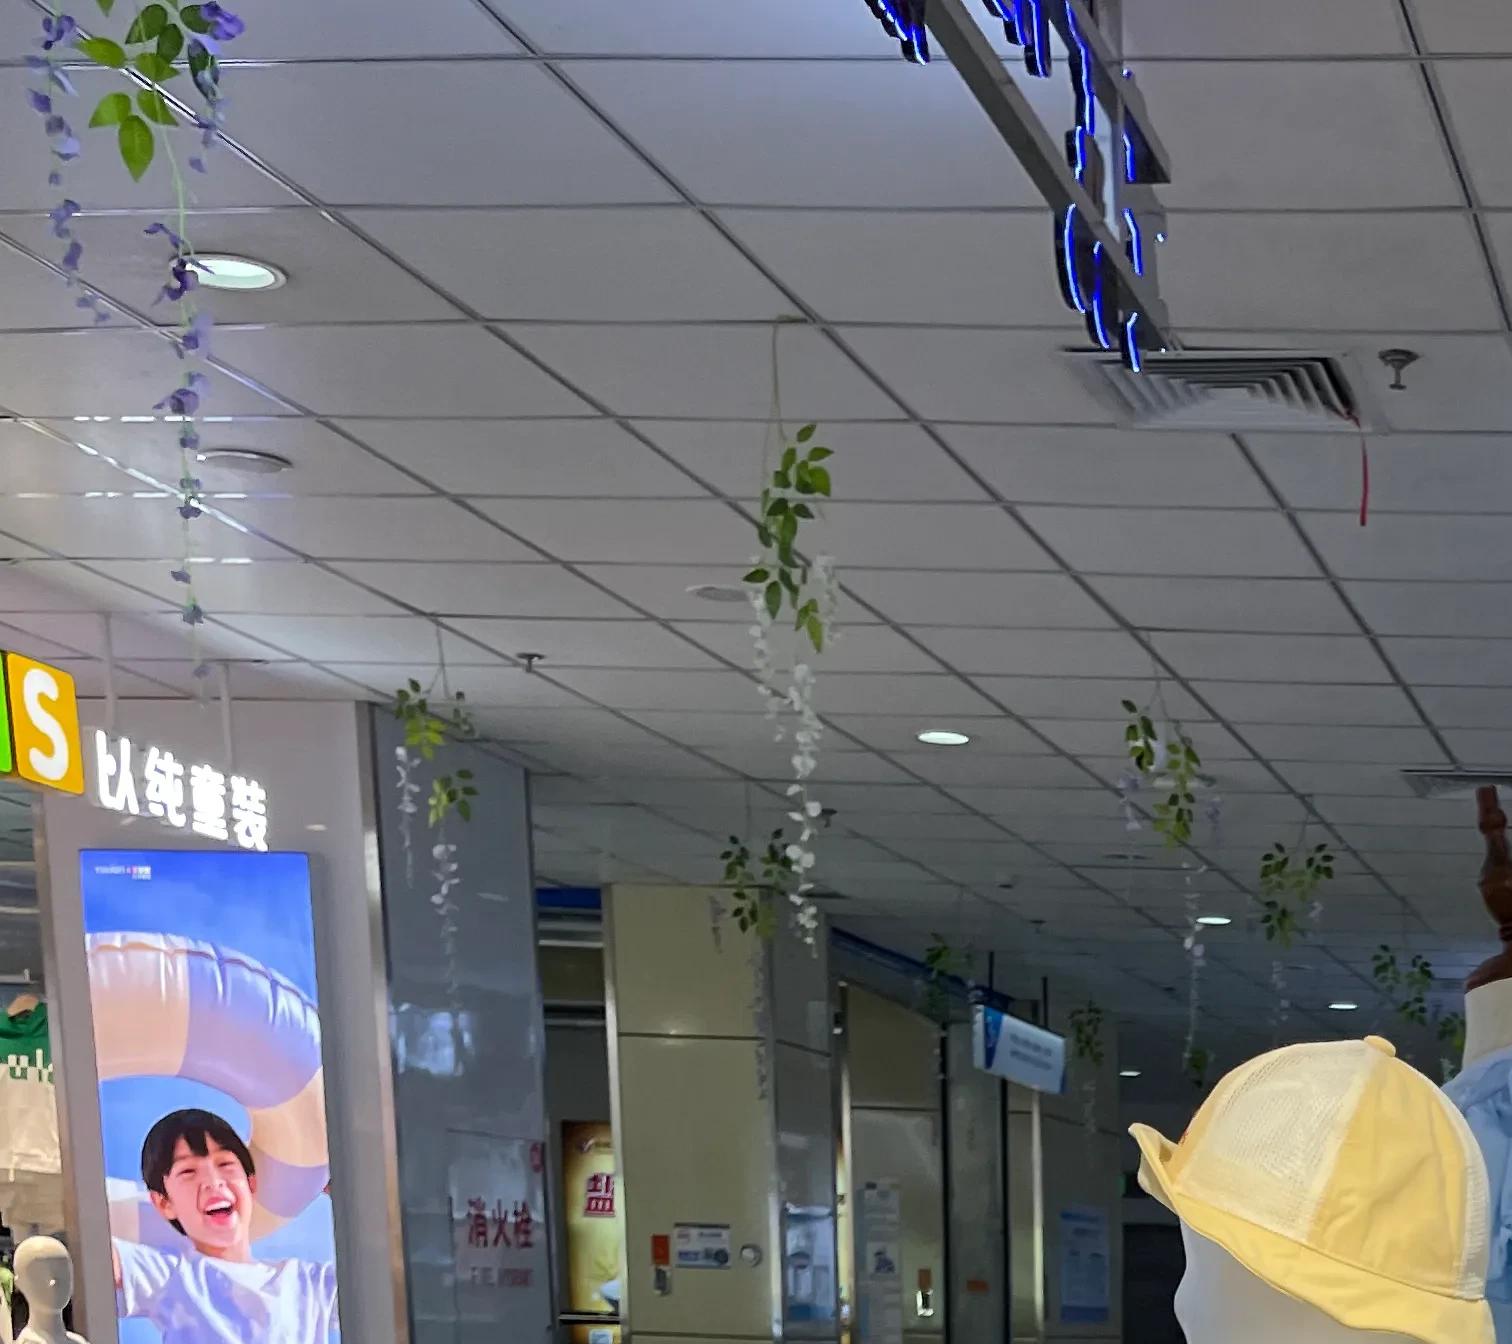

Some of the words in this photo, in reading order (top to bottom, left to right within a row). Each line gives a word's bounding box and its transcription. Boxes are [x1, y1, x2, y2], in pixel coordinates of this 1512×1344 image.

[23, 667, 69, 781] S
[95, 730, 268, 851] 以纯童装
